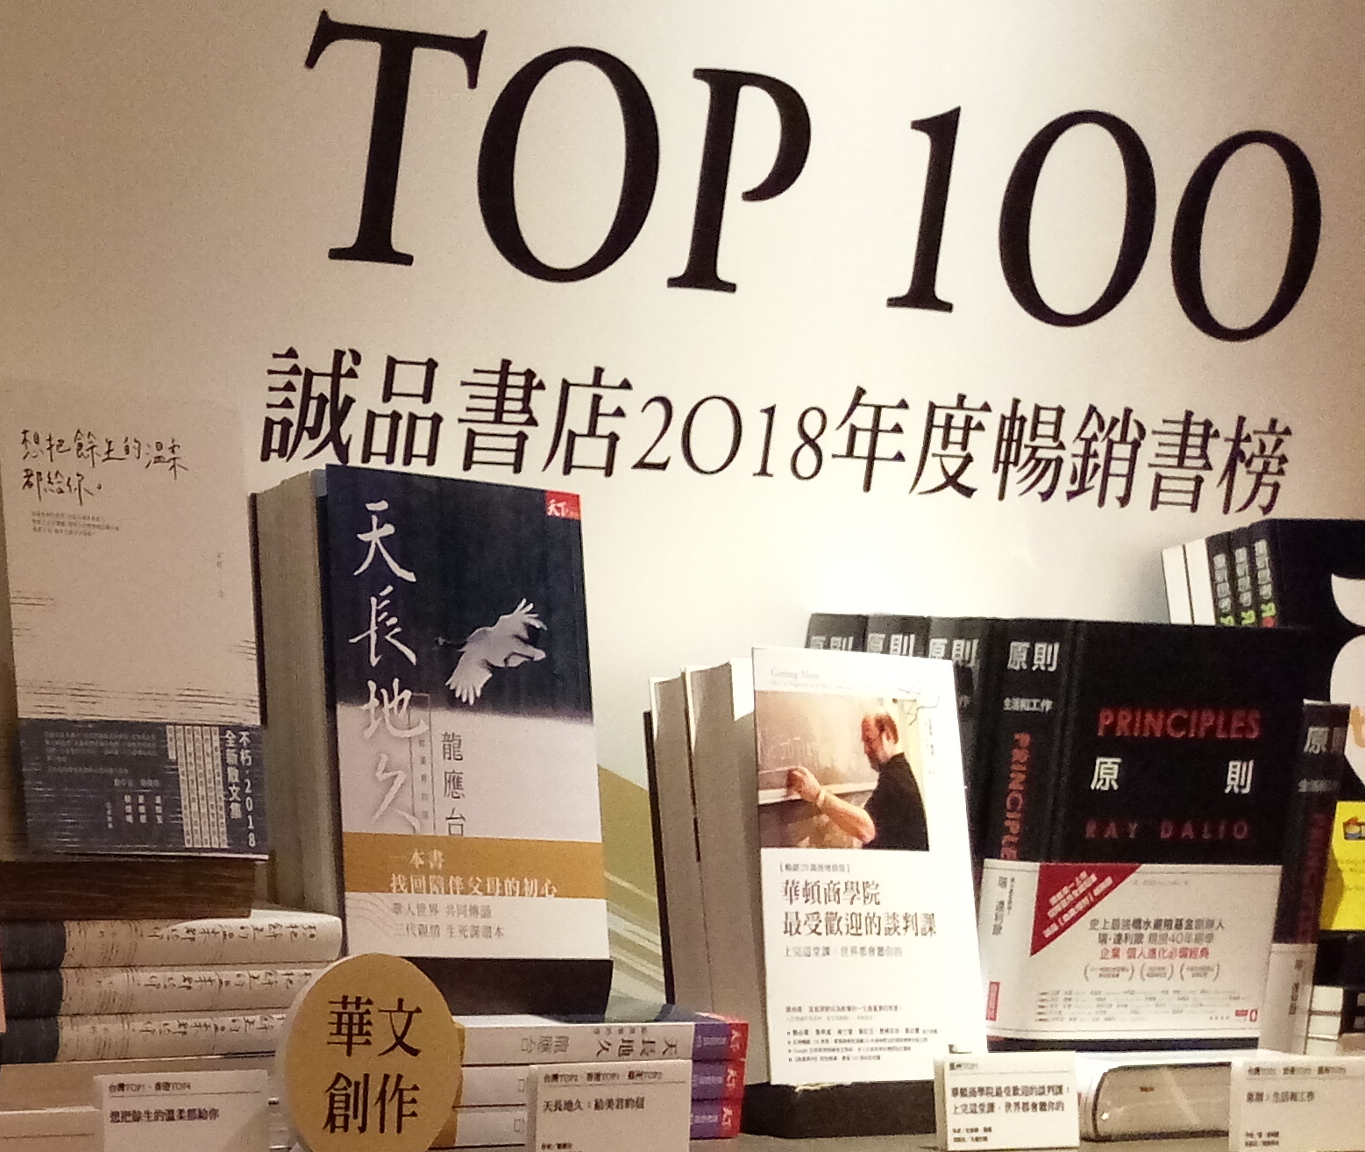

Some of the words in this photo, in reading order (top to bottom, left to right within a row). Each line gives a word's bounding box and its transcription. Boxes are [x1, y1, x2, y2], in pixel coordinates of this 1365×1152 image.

[306, 10, 812, 294] TOP
[887, 106, 1322, 342] 100
[259, 347, 1293, 516] 誠品書店2018年度暢銷書榜
[349, 500, 429, 834] 天長地久
[927, 638, 980, 668] 原則
[1007, 642, 1057, 671] 原則
[1097, 706, 1262, 740] PRINCIPLES
[441, 731, 466, 836] 龍應台
[1085, 819, 1139, 840] RAY
[1159, 820, 1250, 841] DALIO
[390, 849, 443, 869] 一本書
[390, 873, 557, 897] 找回陪伴父母的初心
[781, 878, 881, 906] 華頓商學院
[783, 911, 937, 938] 最受歡迎的談判課
[326, 996, 423, 1058] 華文
[596, 1037, 678, 1058] 天長地久
[322, 1071, 421, 1135] 創作
